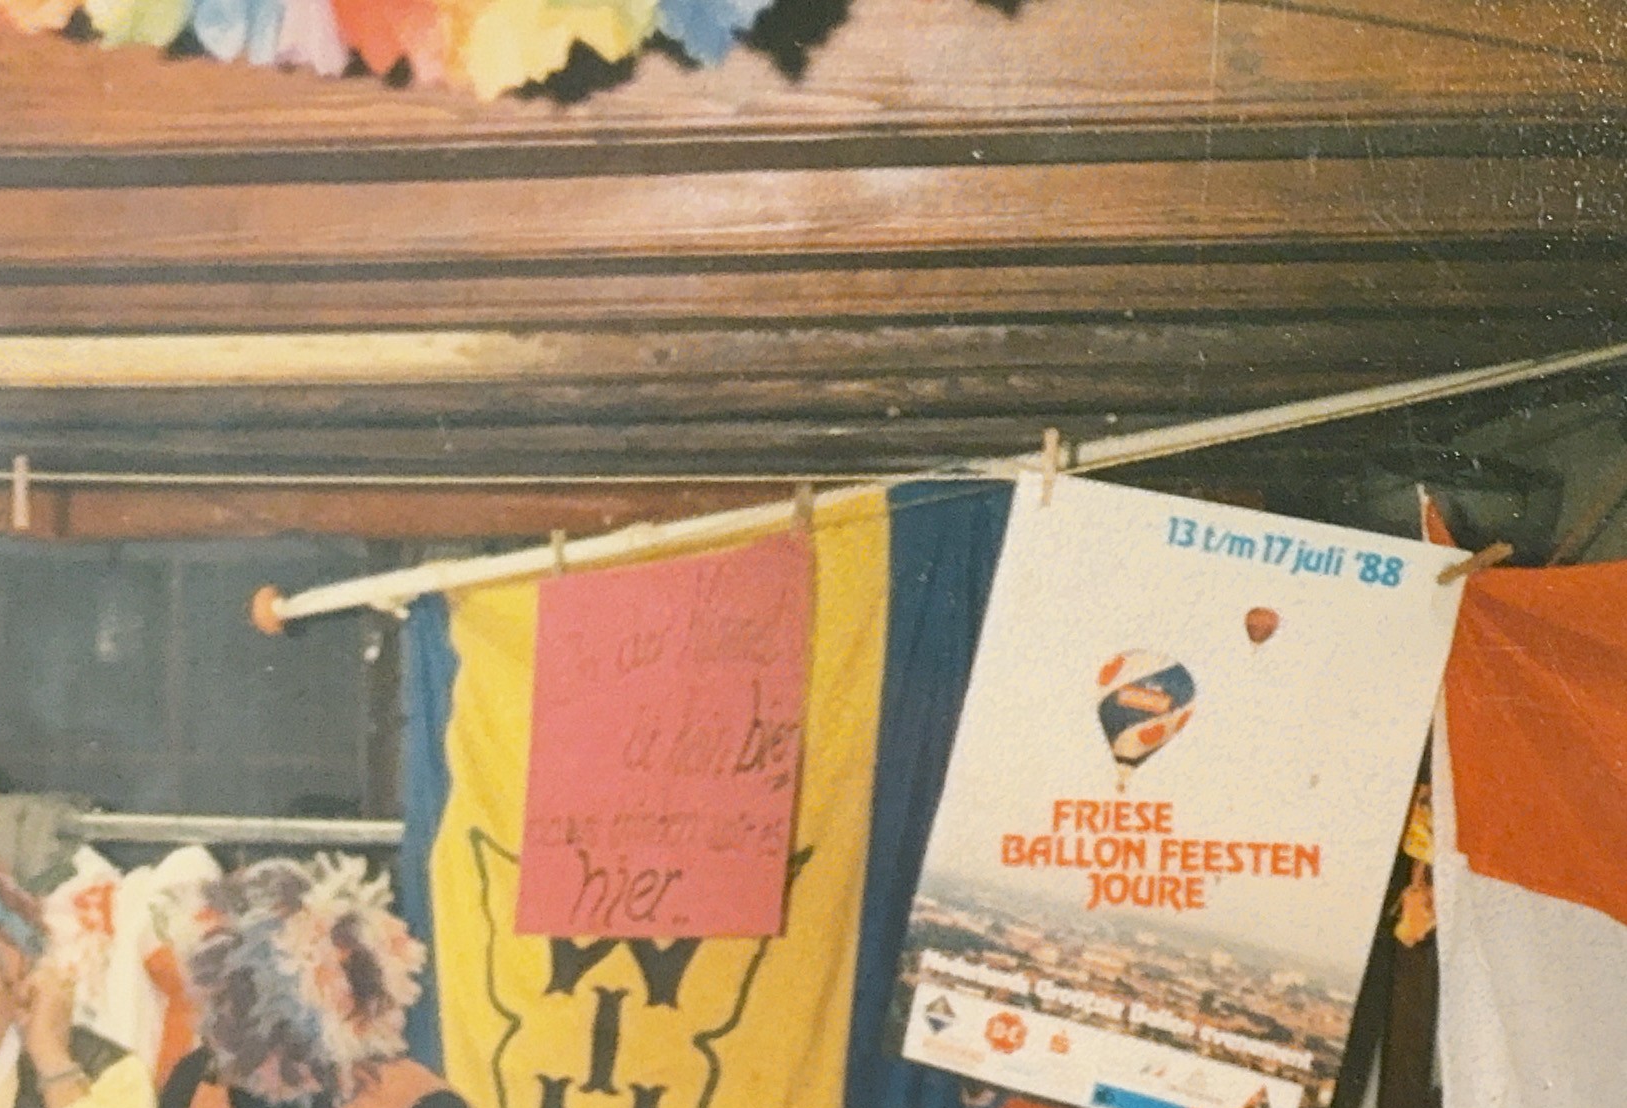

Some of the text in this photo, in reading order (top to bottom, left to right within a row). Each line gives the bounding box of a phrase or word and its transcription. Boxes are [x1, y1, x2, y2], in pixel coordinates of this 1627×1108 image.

[1169, 516, 1405, 588] 13 t/m 17 juli '88
[1001, 834, 1321, 879] BALLON FEESTEN
[1086, 872, 1206, 912] JOURE
